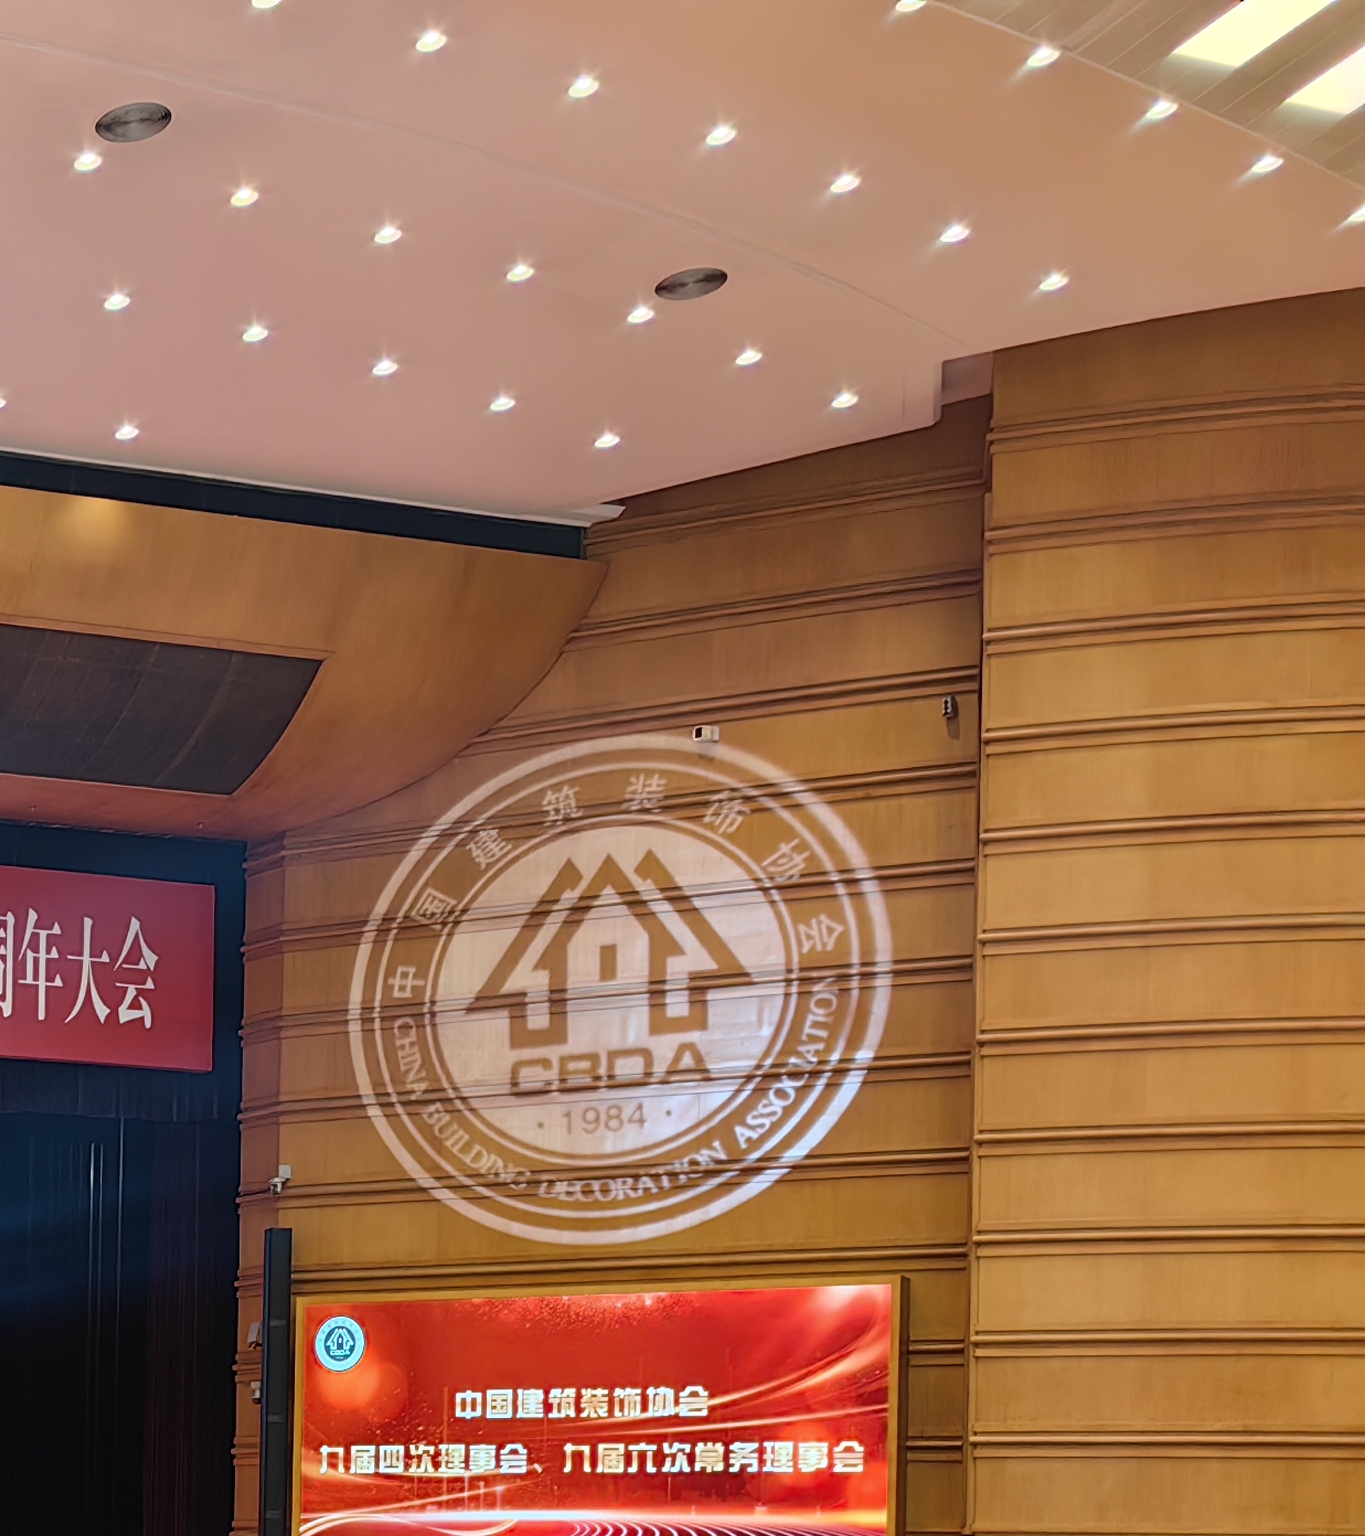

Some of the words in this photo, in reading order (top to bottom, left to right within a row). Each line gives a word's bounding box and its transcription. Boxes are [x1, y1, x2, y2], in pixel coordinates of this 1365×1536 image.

[509, 1040, 715, 1099] CBDA
[393, 1016, 431, 1101] CHINA
[421, 1101, 532, 1191] BUILDING
[537, 1140, 729, 1203] DECORATION
[732, 975, 841, 1151] ASSOCIATION
[561, 1102, 648, 1137] 1984
[454, 1384, 710, 1421] 中国建筑装饰协会
[318, 1439, 866, 1476] 九届四次理事会、九届六次常务理事会
